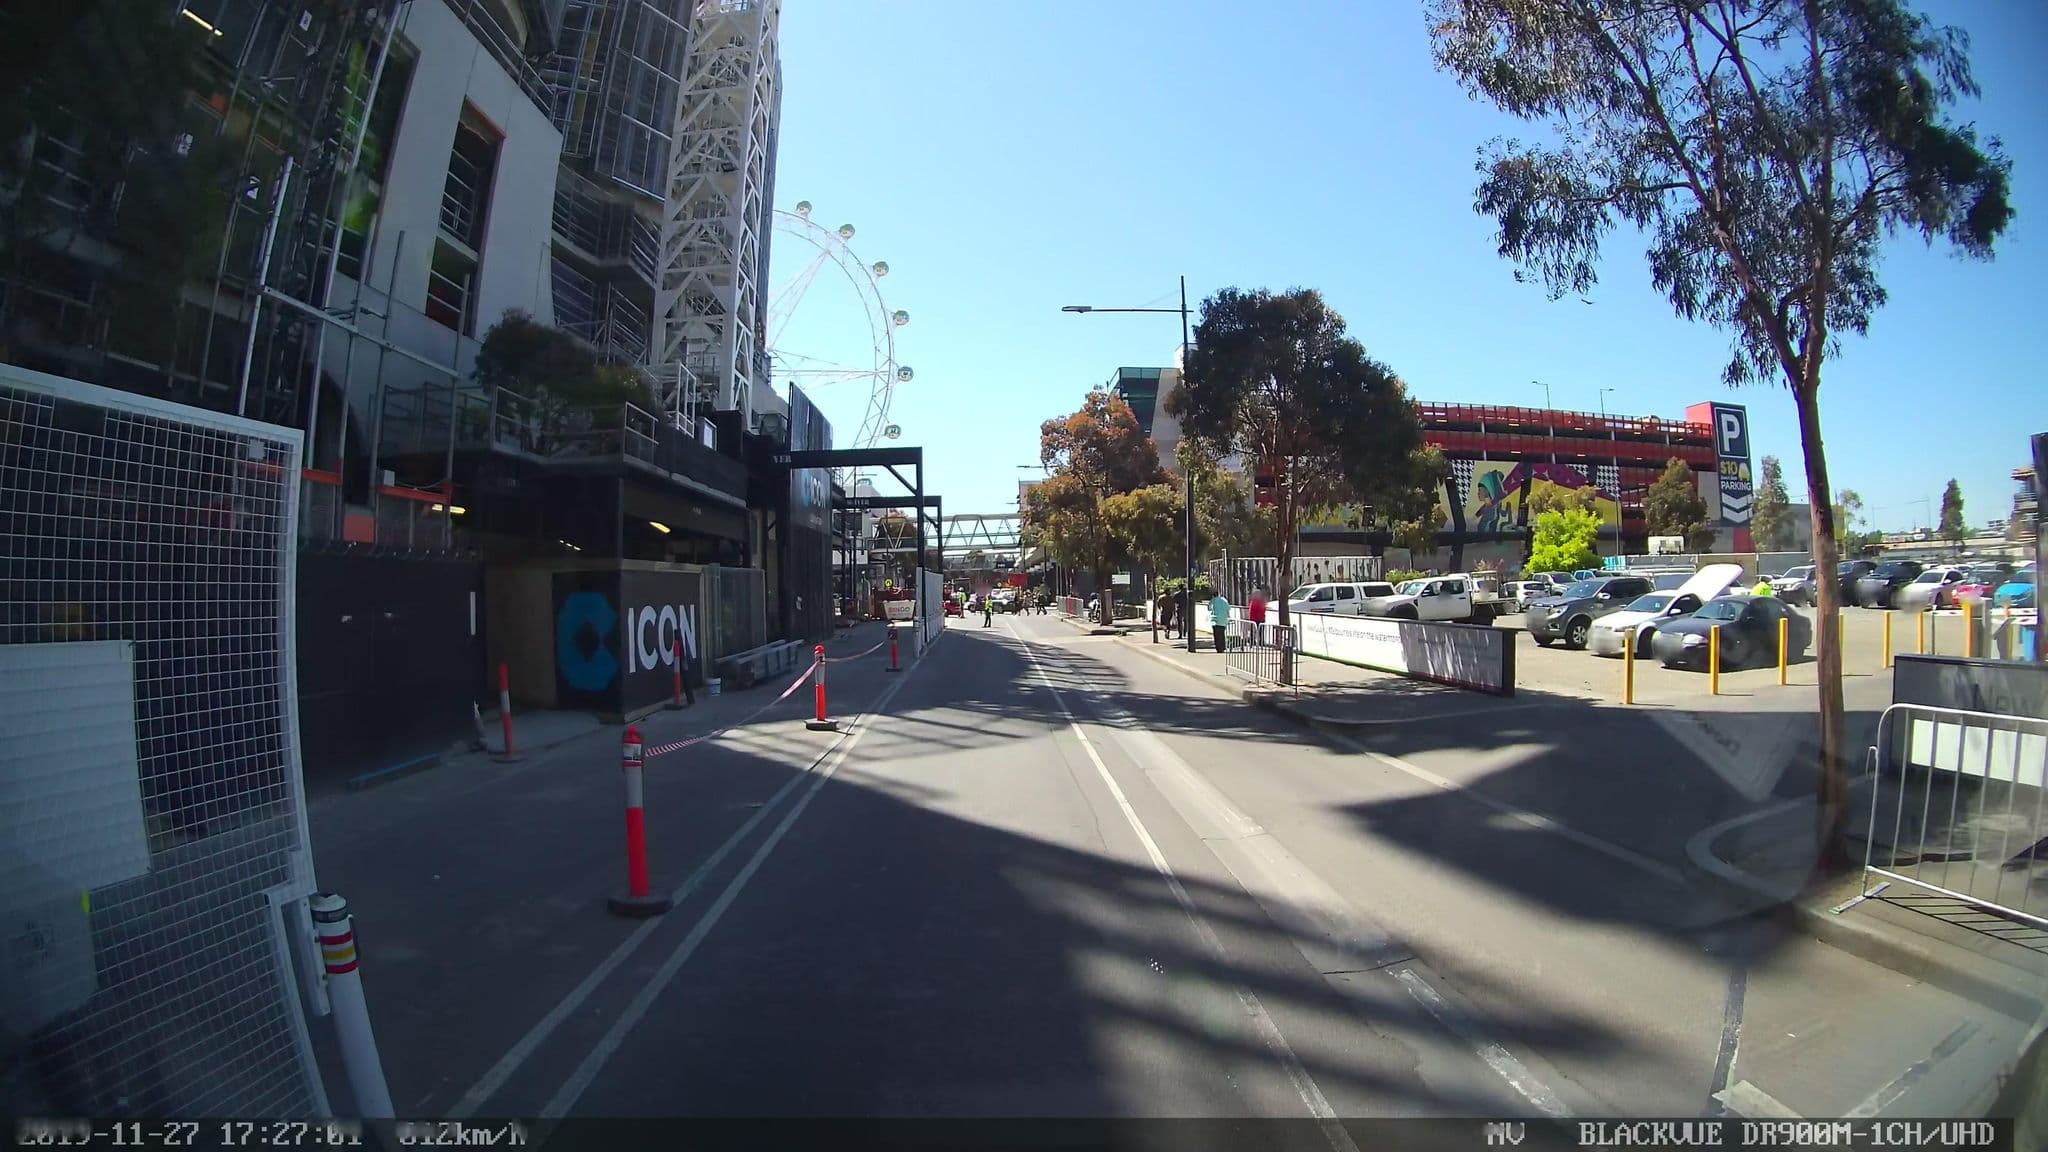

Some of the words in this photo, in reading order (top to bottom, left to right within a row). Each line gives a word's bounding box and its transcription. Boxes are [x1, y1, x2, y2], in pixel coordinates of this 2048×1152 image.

[1721, 413, 1740, 452] P
[1720, 480, 1752, 491] PARKING
[628, 604, 697, 674] ICON
